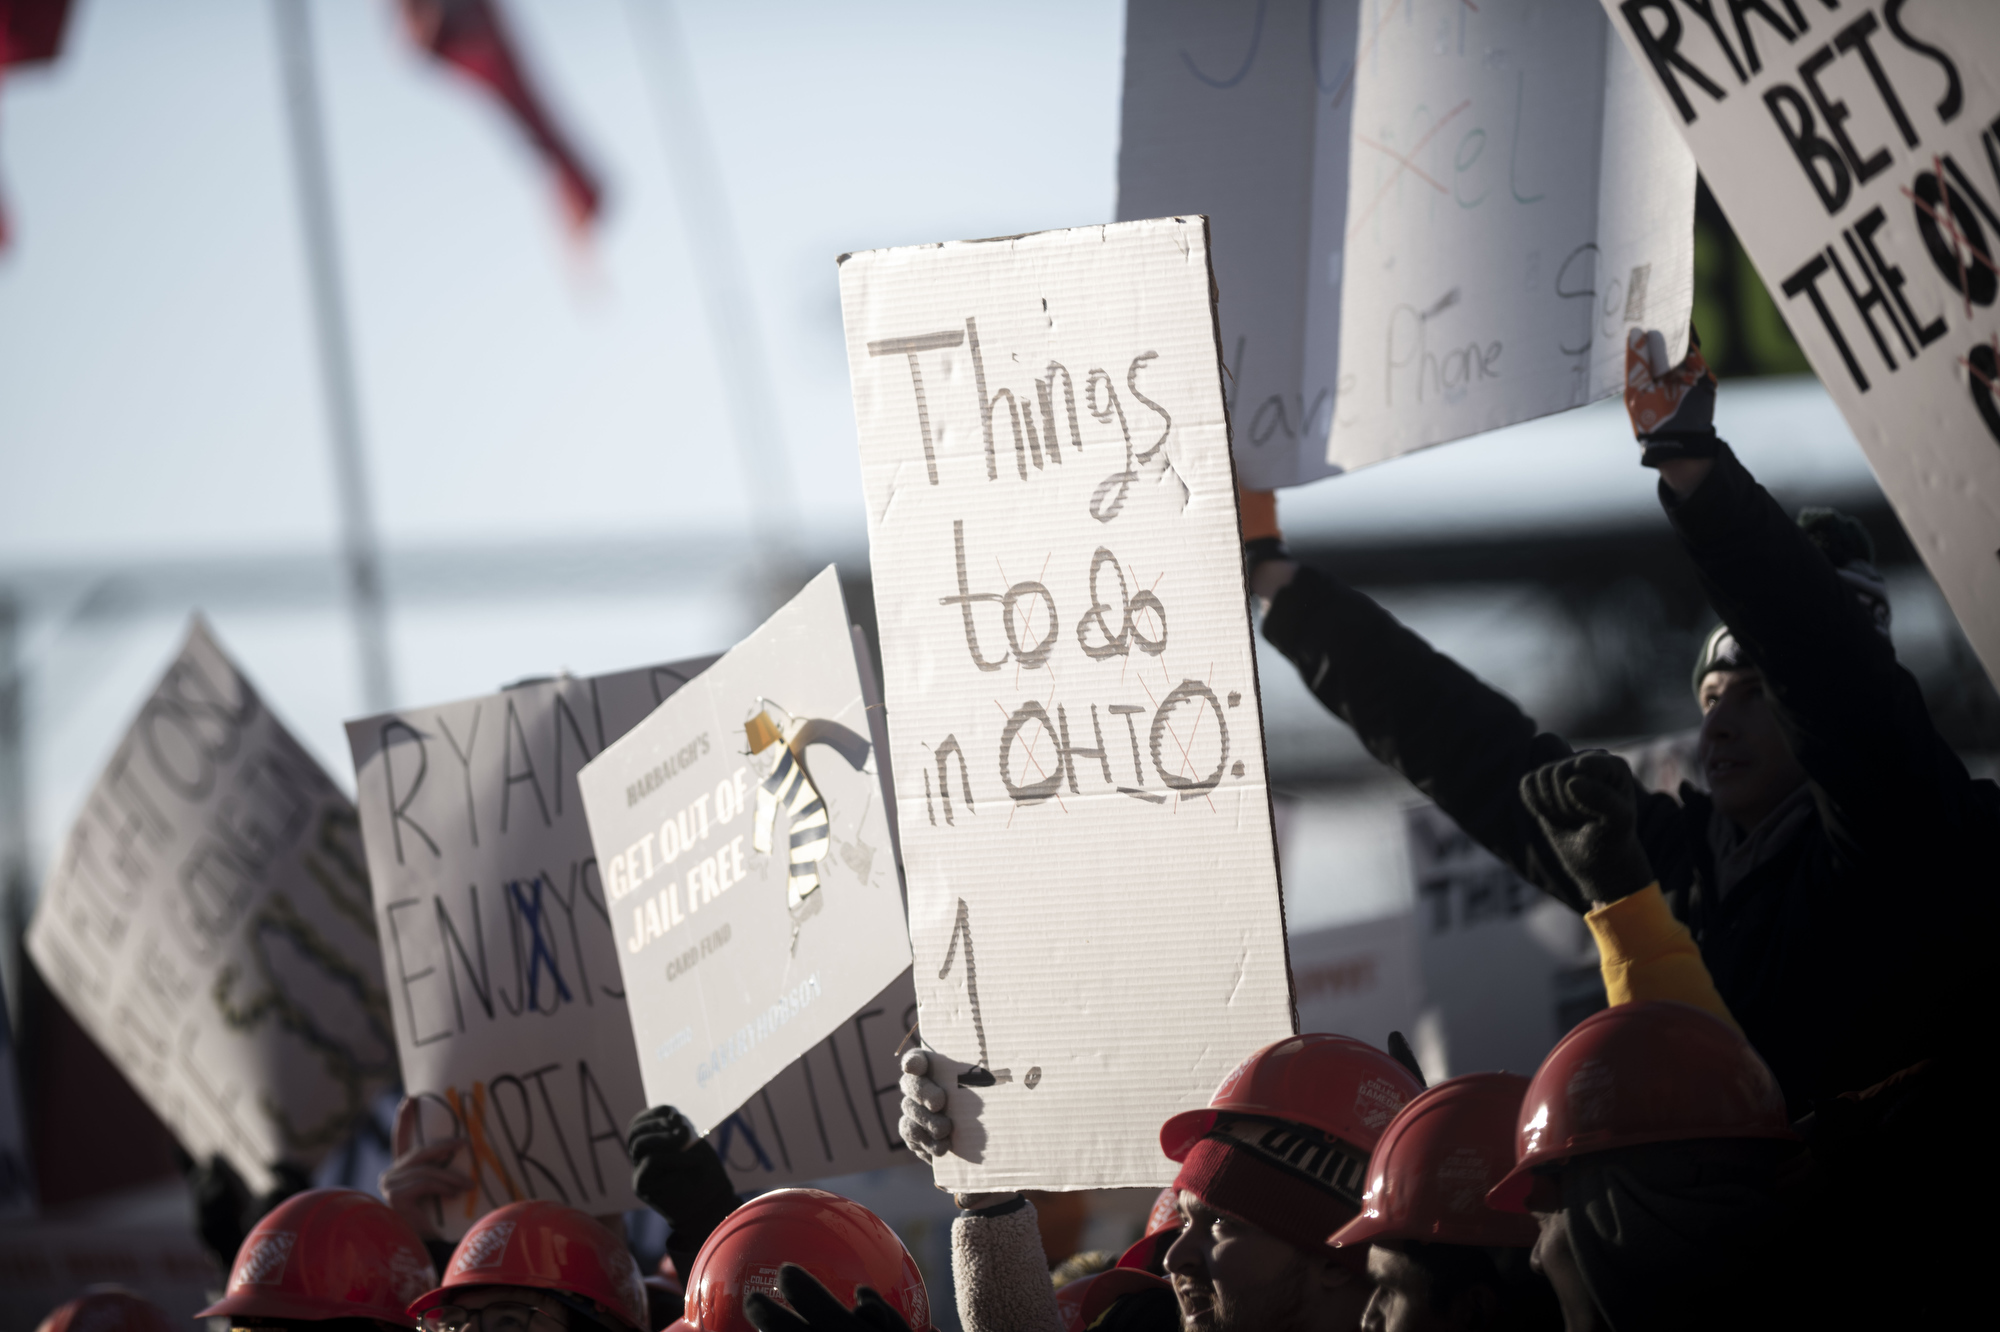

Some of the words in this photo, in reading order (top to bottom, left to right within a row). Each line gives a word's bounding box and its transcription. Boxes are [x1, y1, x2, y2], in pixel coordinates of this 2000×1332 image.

[1763, 0, 1964, 216] BETS
[1384, 300, 1503, 408] Phone
[1781, 205, 1949, 394] THE
[867, 316, 1171, 523] Things
[939, 519, 1059, 671] to
[1076, 545, 1168, 662] do
[380, 677, 605, 865] RYAN
[607, 832, 655, 899] GET
[660, 793, 710, 864] OUT
[715, 766, 748, 825] OF
[626, 732, 711, 808] HARBAUGH'S
[921, 733, 975, 827] in
[627, 882, 685, 954] JAIL
[686, 834, 748, 914] FREE
[665, 945, 699, 982] CARD
[701, 922, 733, 963] FUND
[750, 1275, 779, 1286] COLLEG
